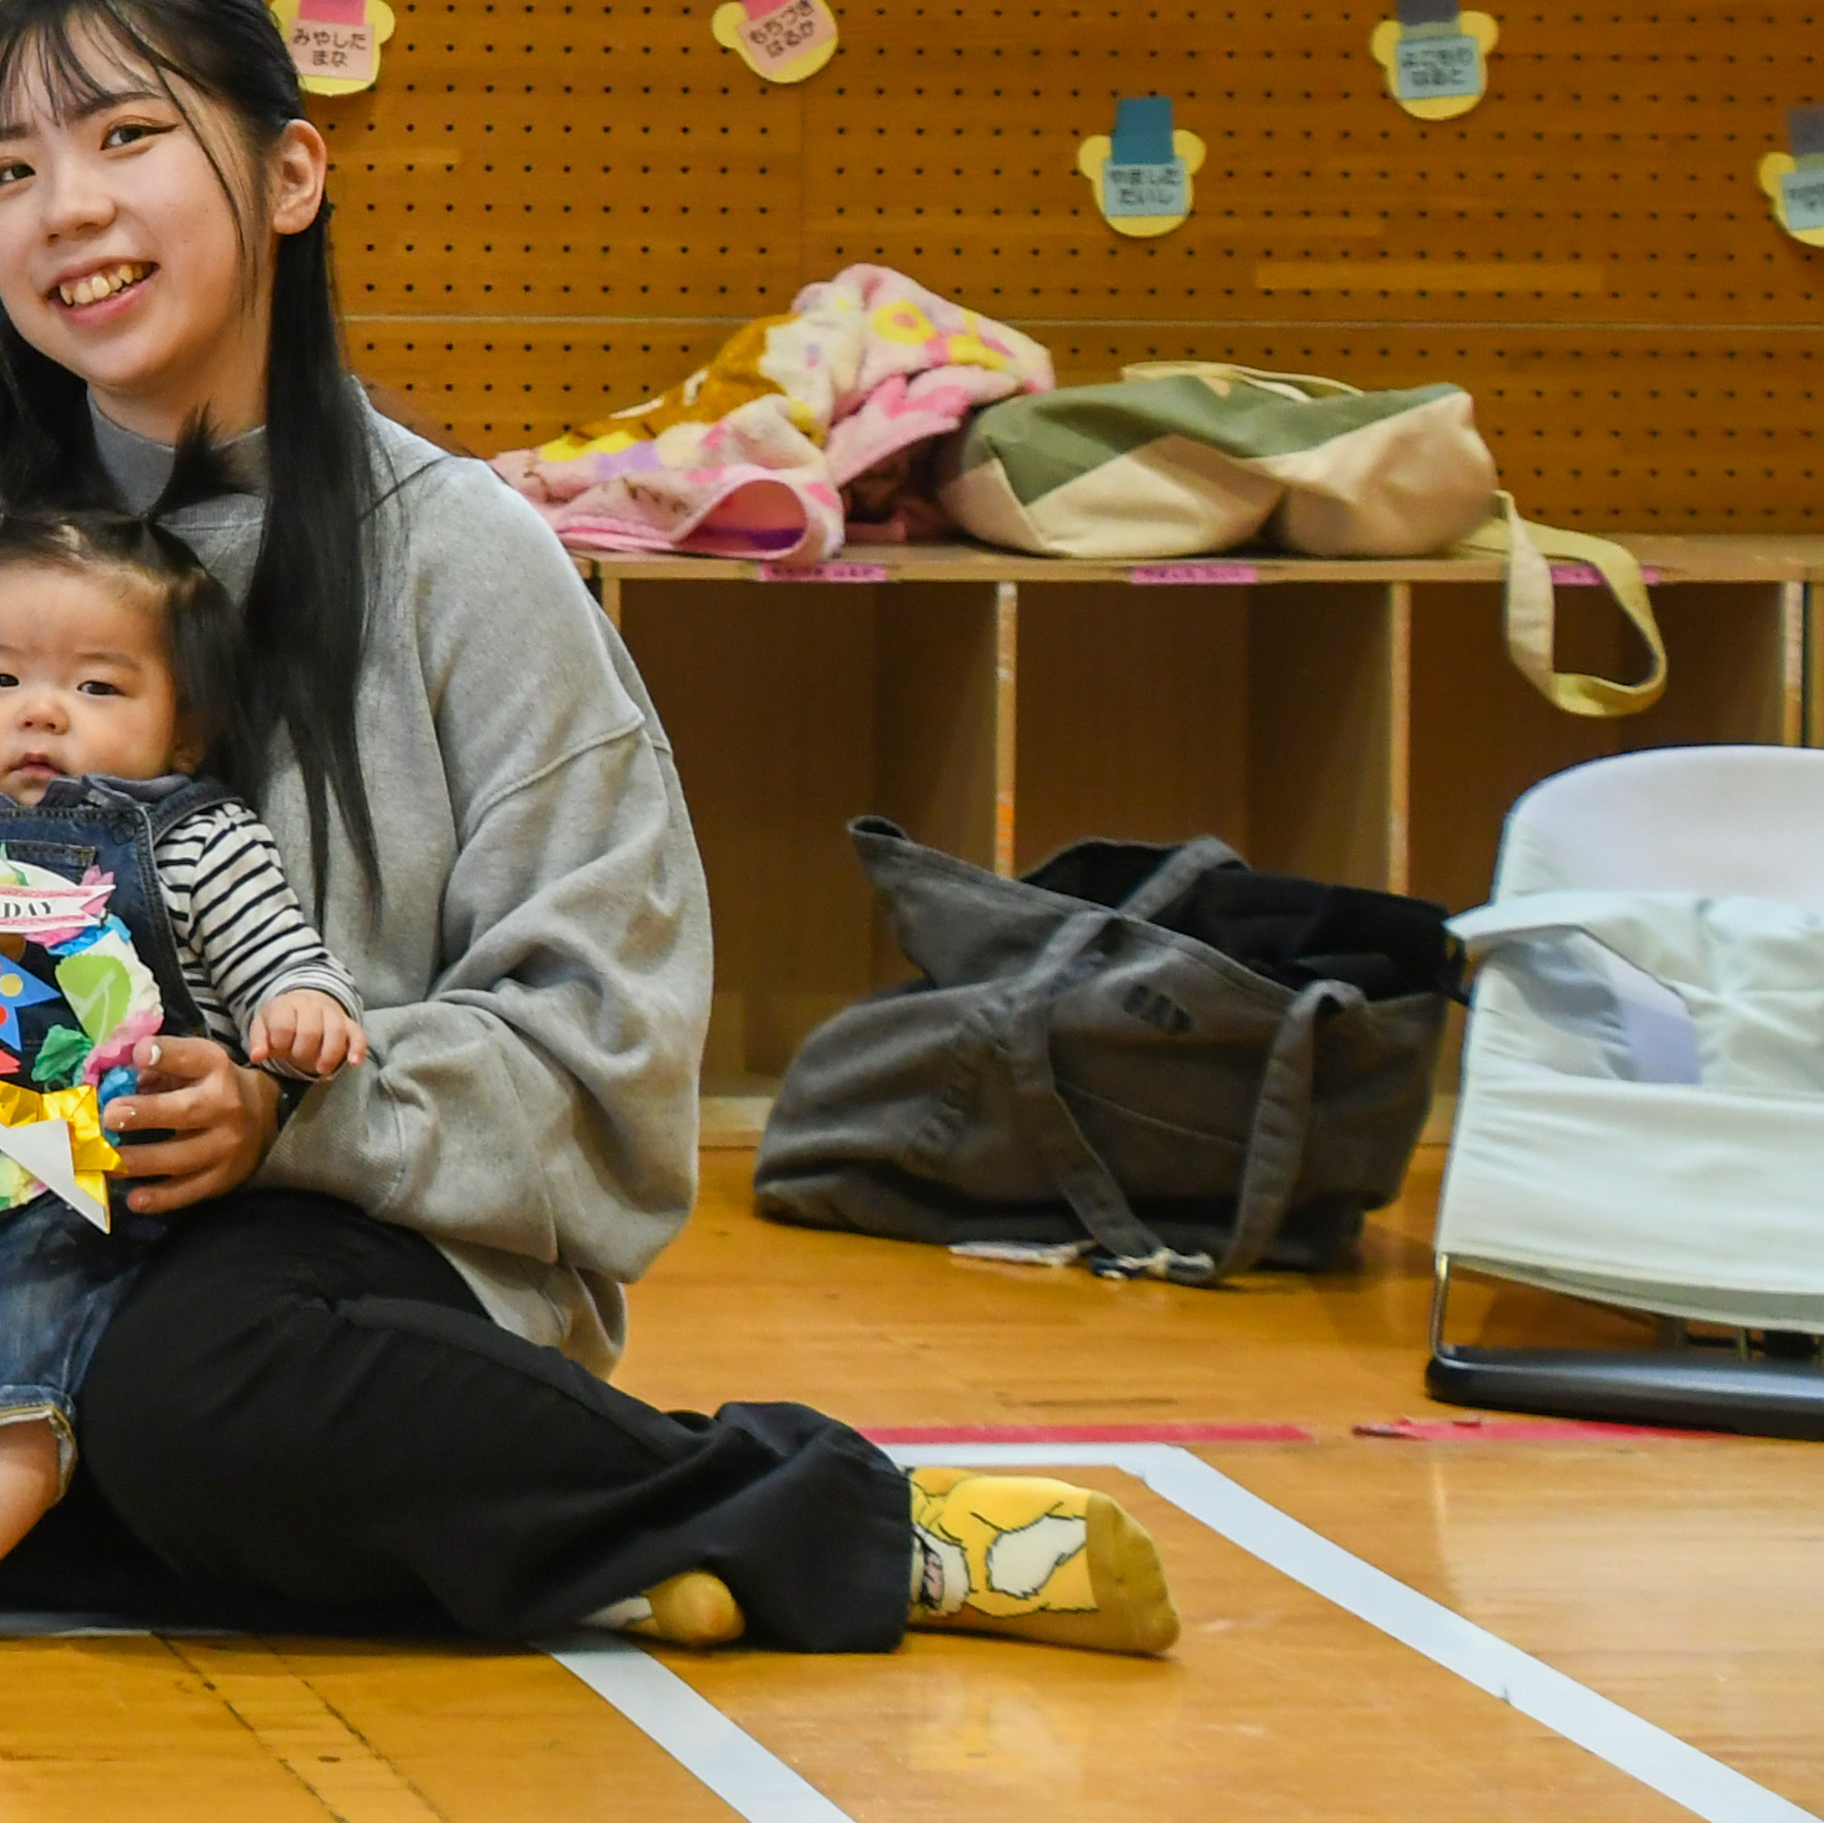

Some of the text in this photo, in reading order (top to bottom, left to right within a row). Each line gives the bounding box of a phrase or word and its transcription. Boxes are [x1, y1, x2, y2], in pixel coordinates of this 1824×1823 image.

[292, 28, 367, 51] みやした
[312, 50, 348, 68] まな
[4, 901, 55, 919] DAY
